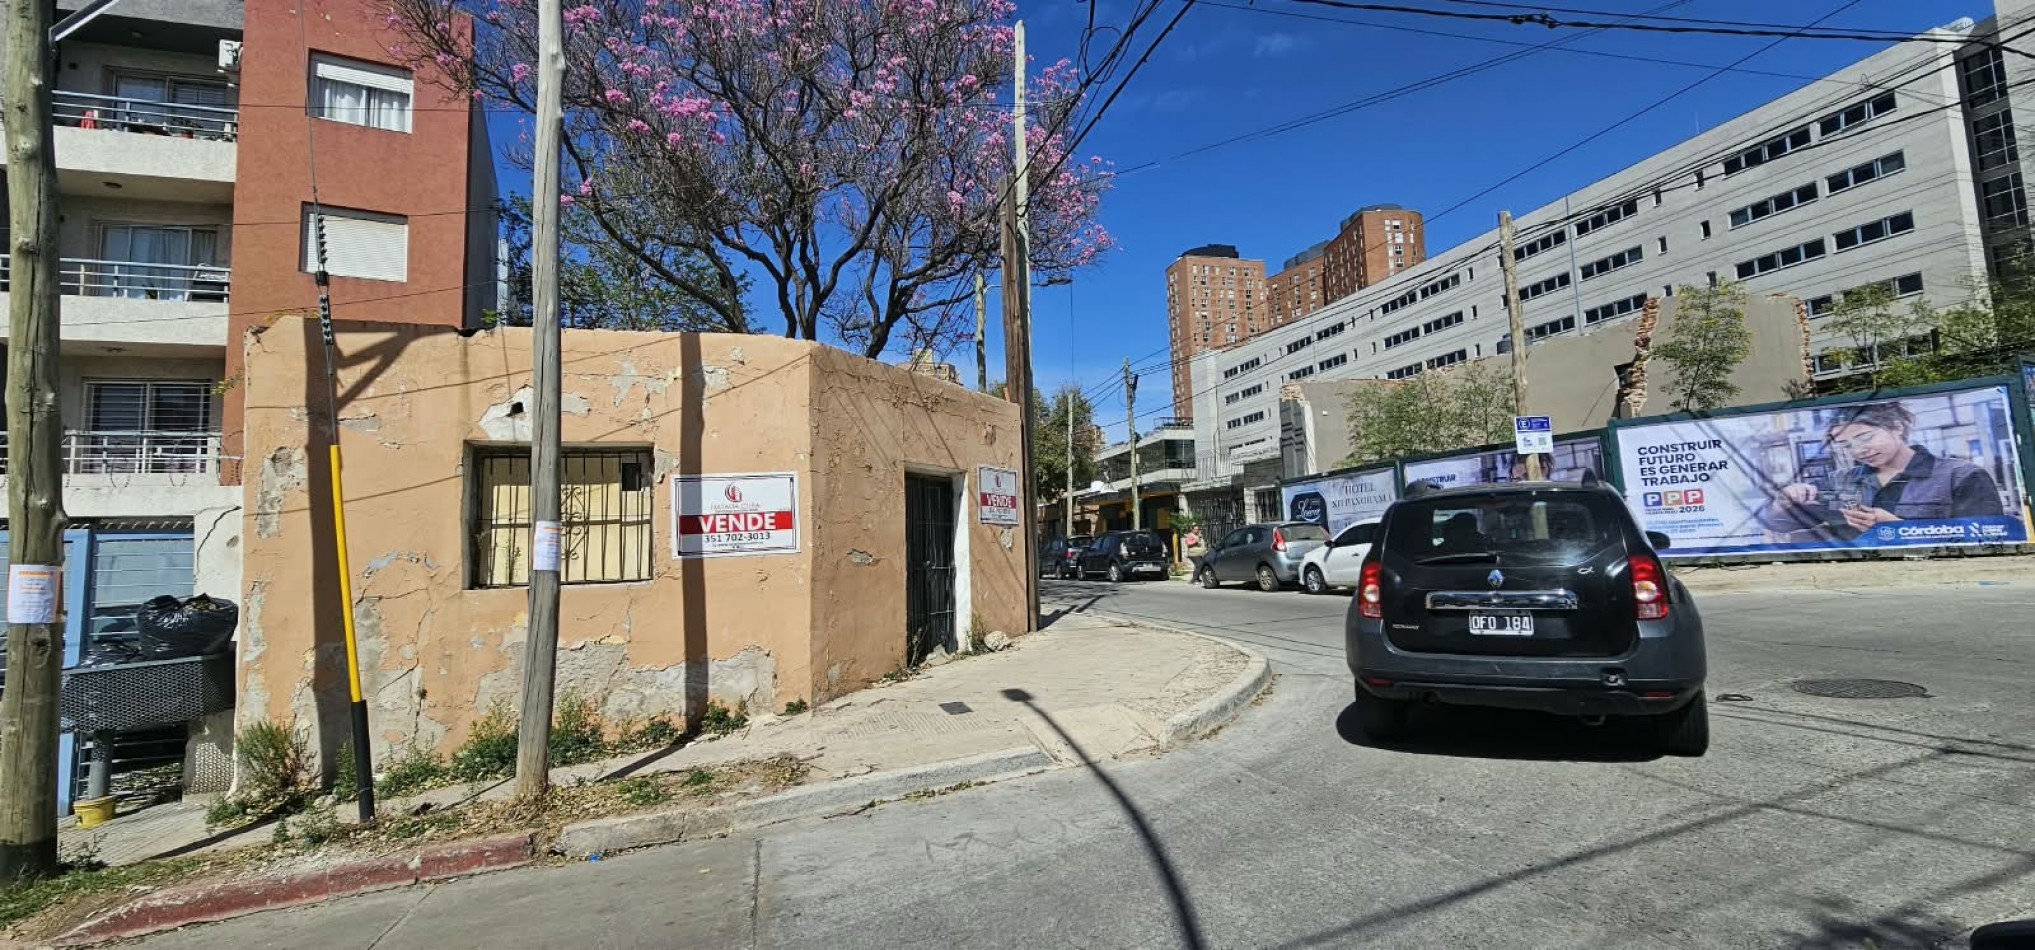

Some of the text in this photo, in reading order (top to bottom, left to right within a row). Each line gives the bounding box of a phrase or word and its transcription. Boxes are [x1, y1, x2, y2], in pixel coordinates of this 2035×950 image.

[1637, 440, 1721, 455] CONSTRUIR
[1639, 453, 1696, 466] FUTURO
[1640, 460, 1728, 476] ES GENERAR
[1641, 473, 1710, 486] TRABAJO
[986, 494, 1011, 507] VENDE
[698, 512, 776, 533] VENDE
[1899, 525, 1965, 535] Córdoba
[705, 532, 771, 543] 351 702-3013
[1504, 616, 1531, 630] 184
